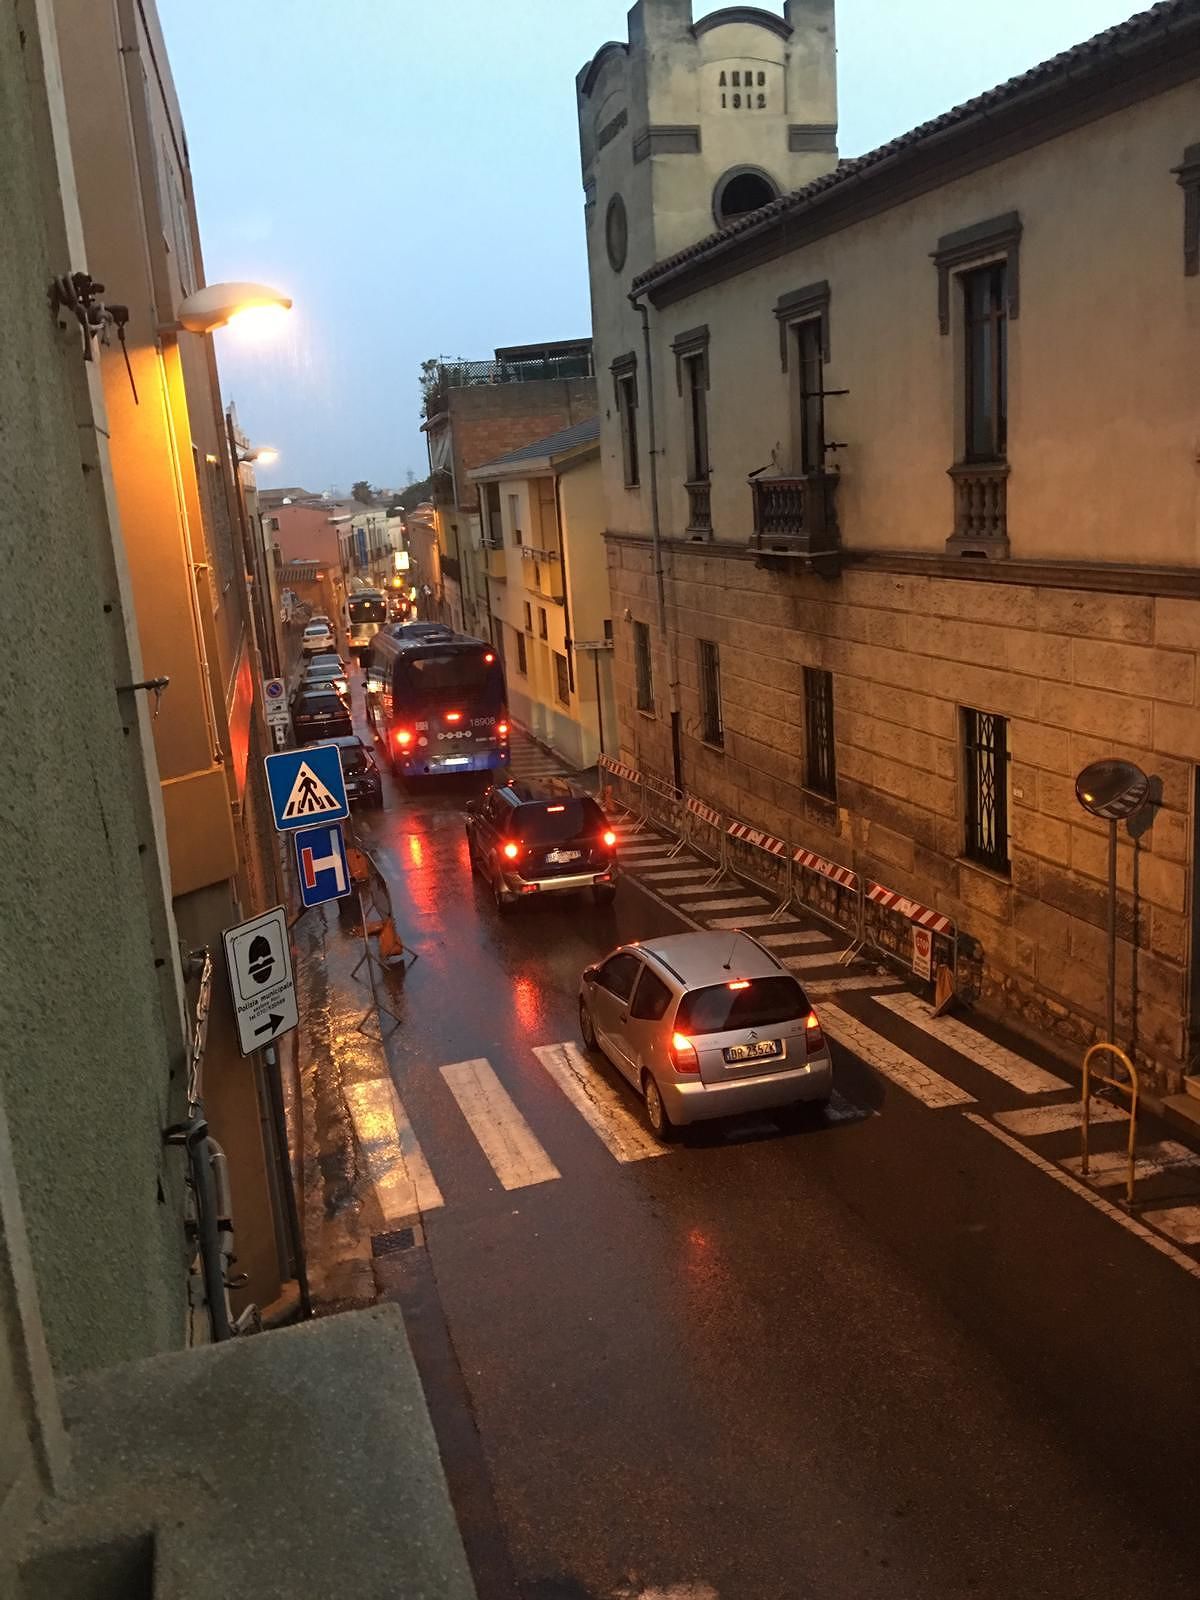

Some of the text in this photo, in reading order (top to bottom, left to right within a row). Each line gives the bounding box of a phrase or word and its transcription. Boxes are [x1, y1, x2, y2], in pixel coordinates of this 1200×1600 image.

[719, 70, 766, 87] ANNO
[721, 93, 767, 109] 1912
[237, 999, 259, 1014] Polizia
[260, 981, 293, 1002] municipale
